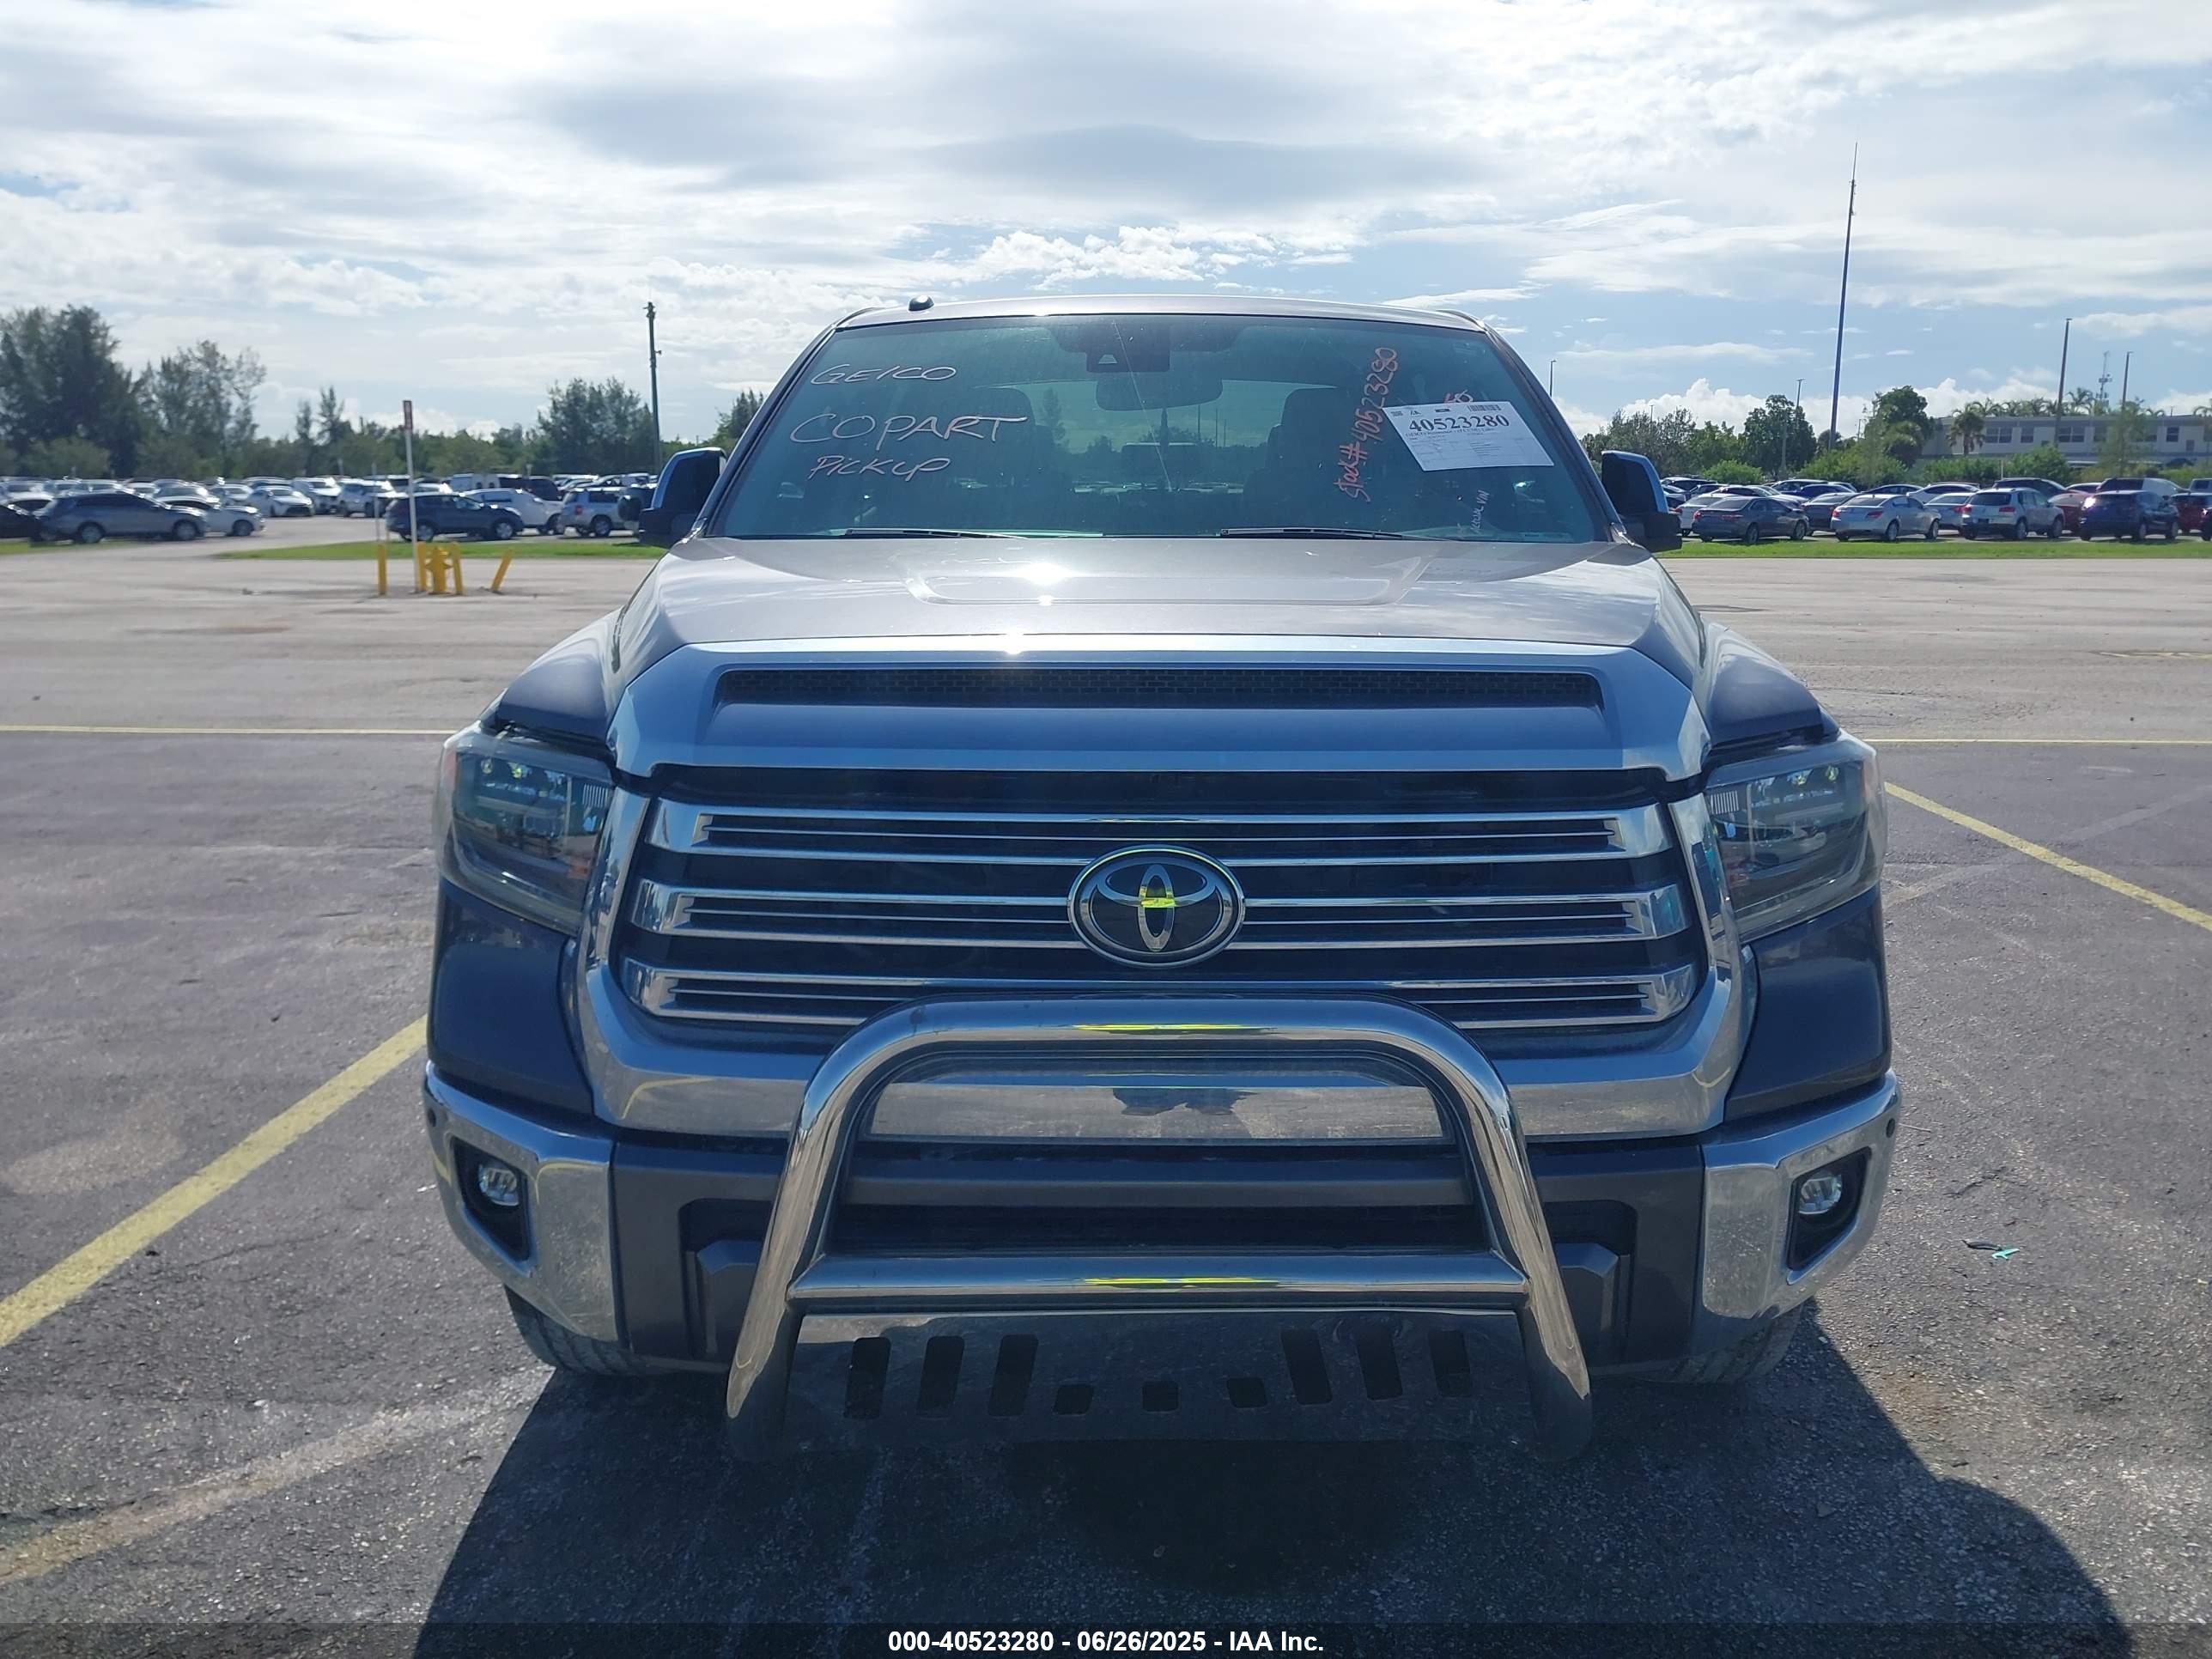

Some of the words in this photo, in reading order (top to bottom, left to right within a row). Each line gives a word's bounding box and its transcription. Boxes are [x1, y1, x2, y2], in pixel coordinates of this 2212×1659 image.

[810, 364, 957, 385] GEICO
[790, 413, 1028, 451] COPART
[1408, 414, 1510, 432] 40523280
